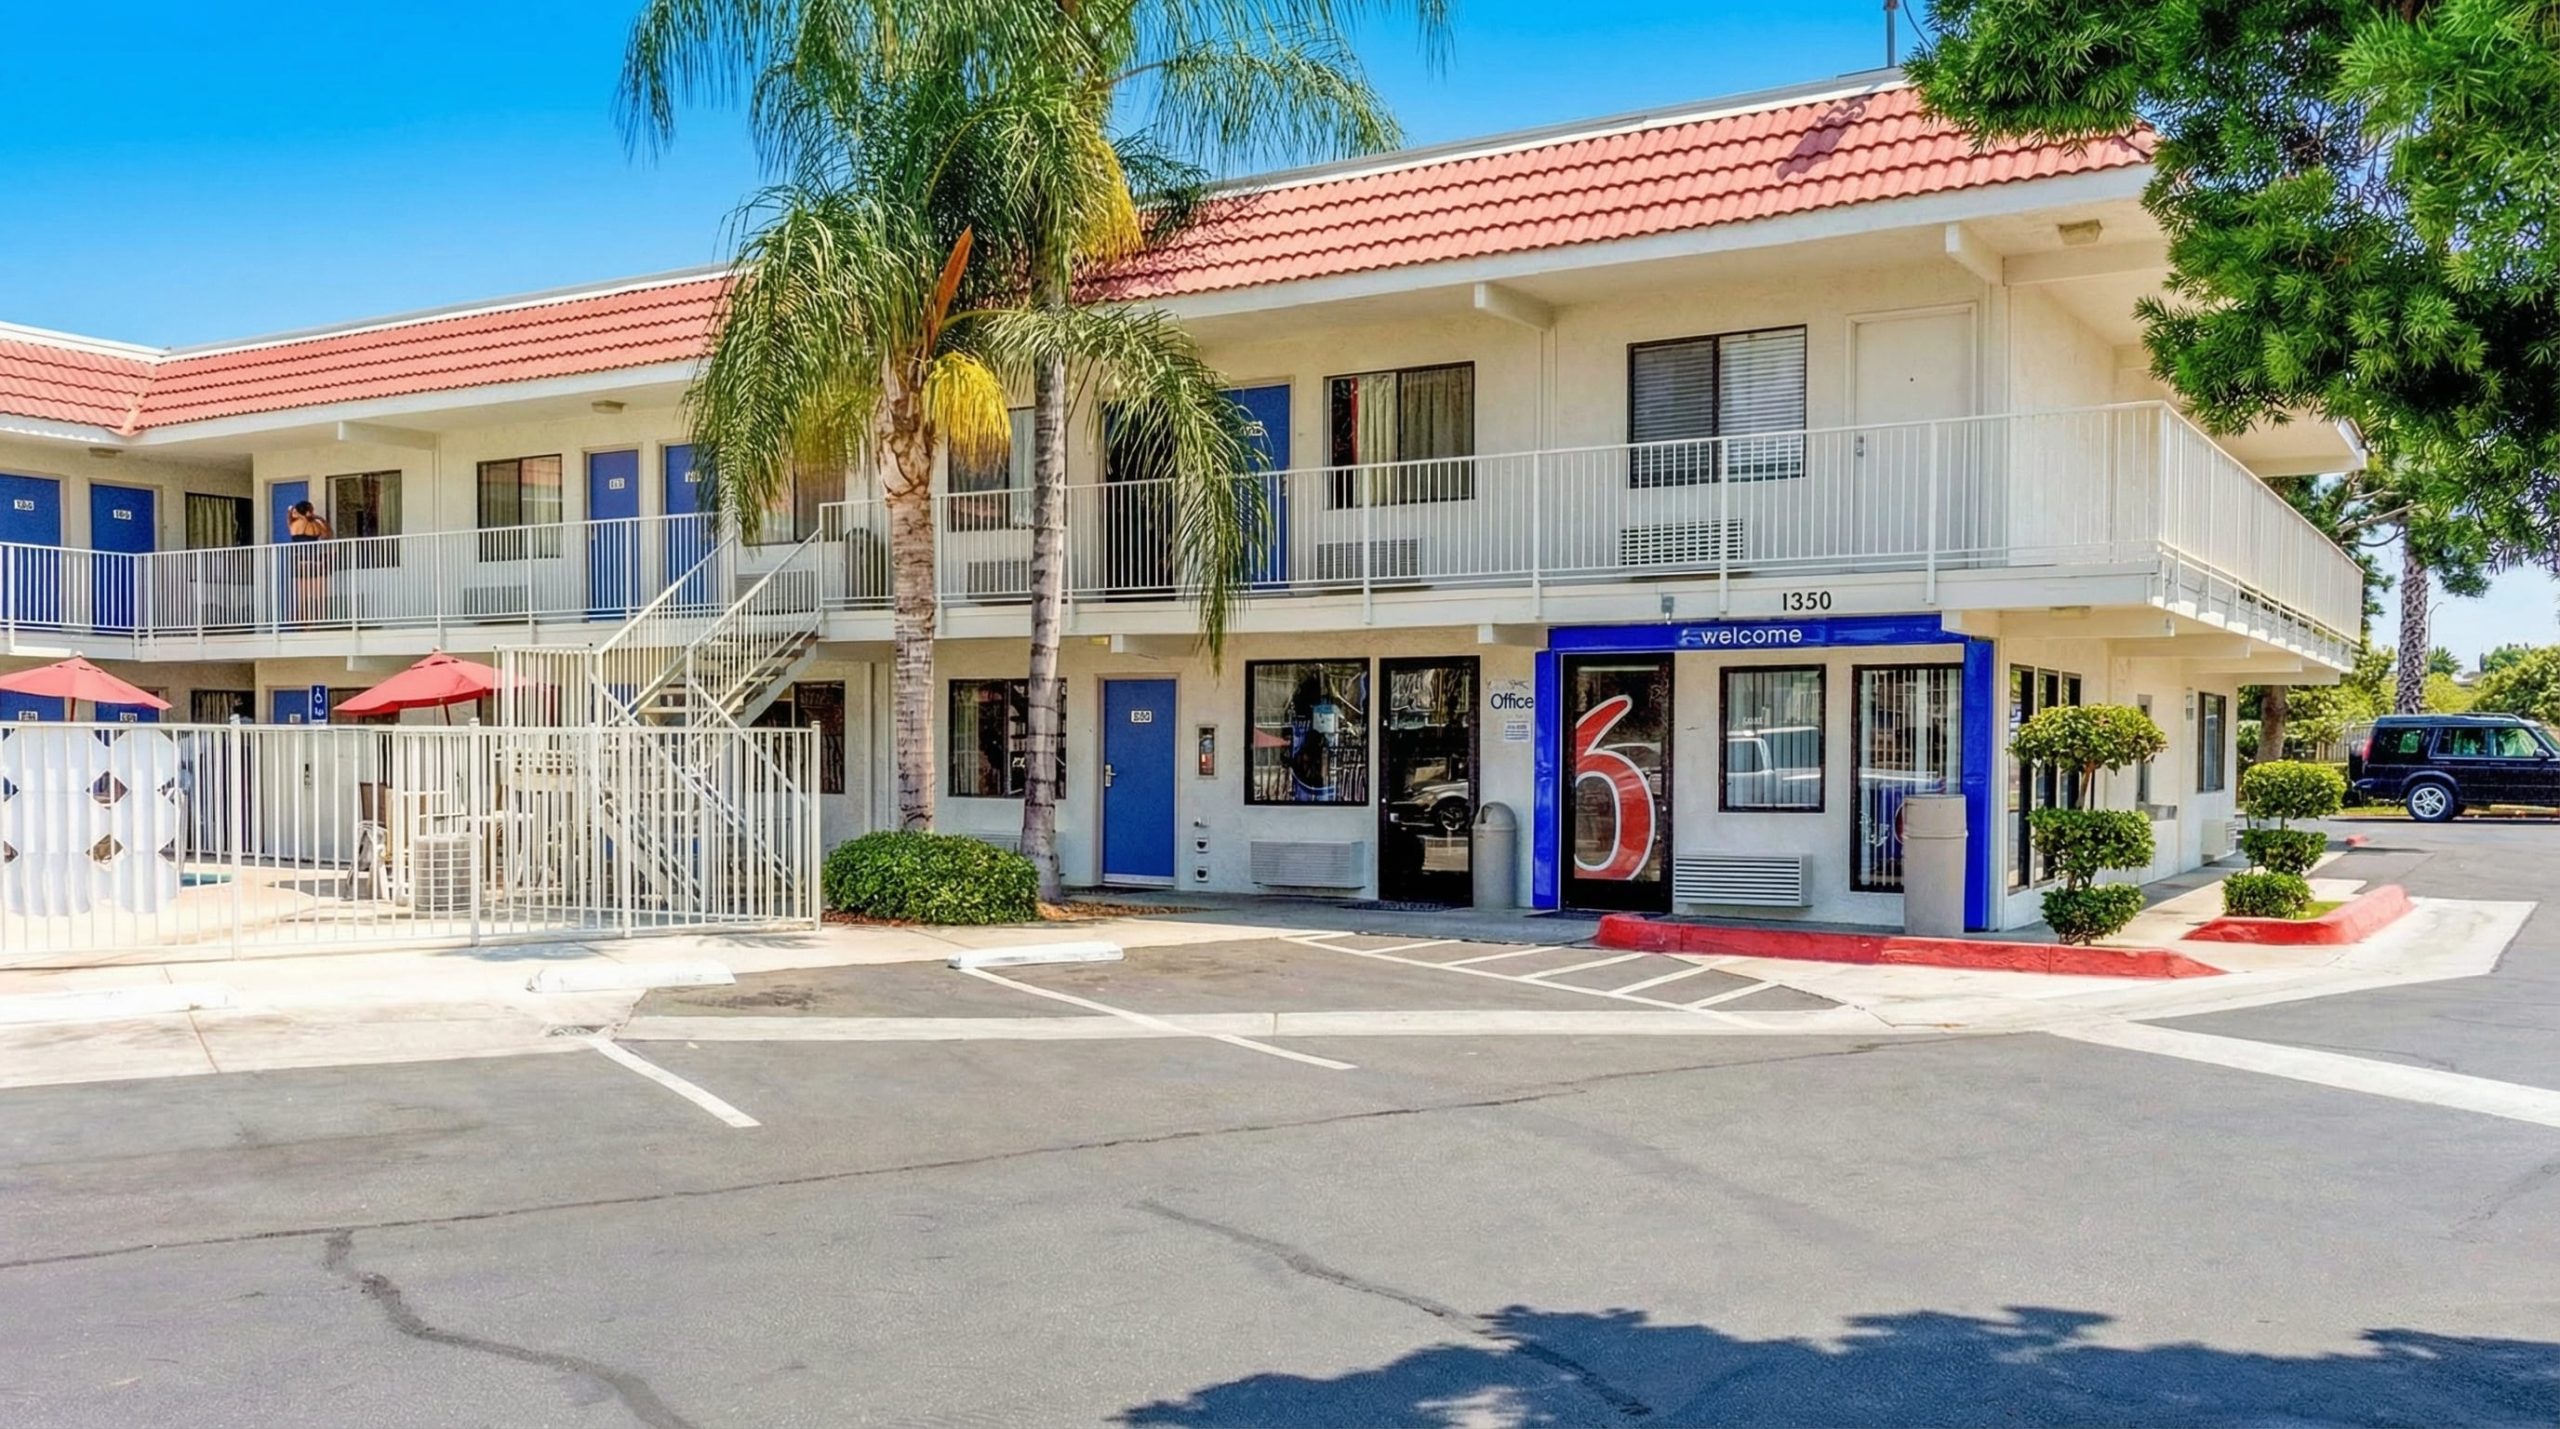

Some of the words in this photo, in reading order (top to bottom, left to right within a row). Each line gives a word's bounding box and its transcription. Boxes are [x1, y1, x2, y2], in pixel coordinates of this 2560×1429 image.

[1783, 591, 1832, 611] 1350
[1701, 627, 1803, 644] welcome
[1490, 692, 1534, 710] Office
[1575, 694, 1656, 881] 6
